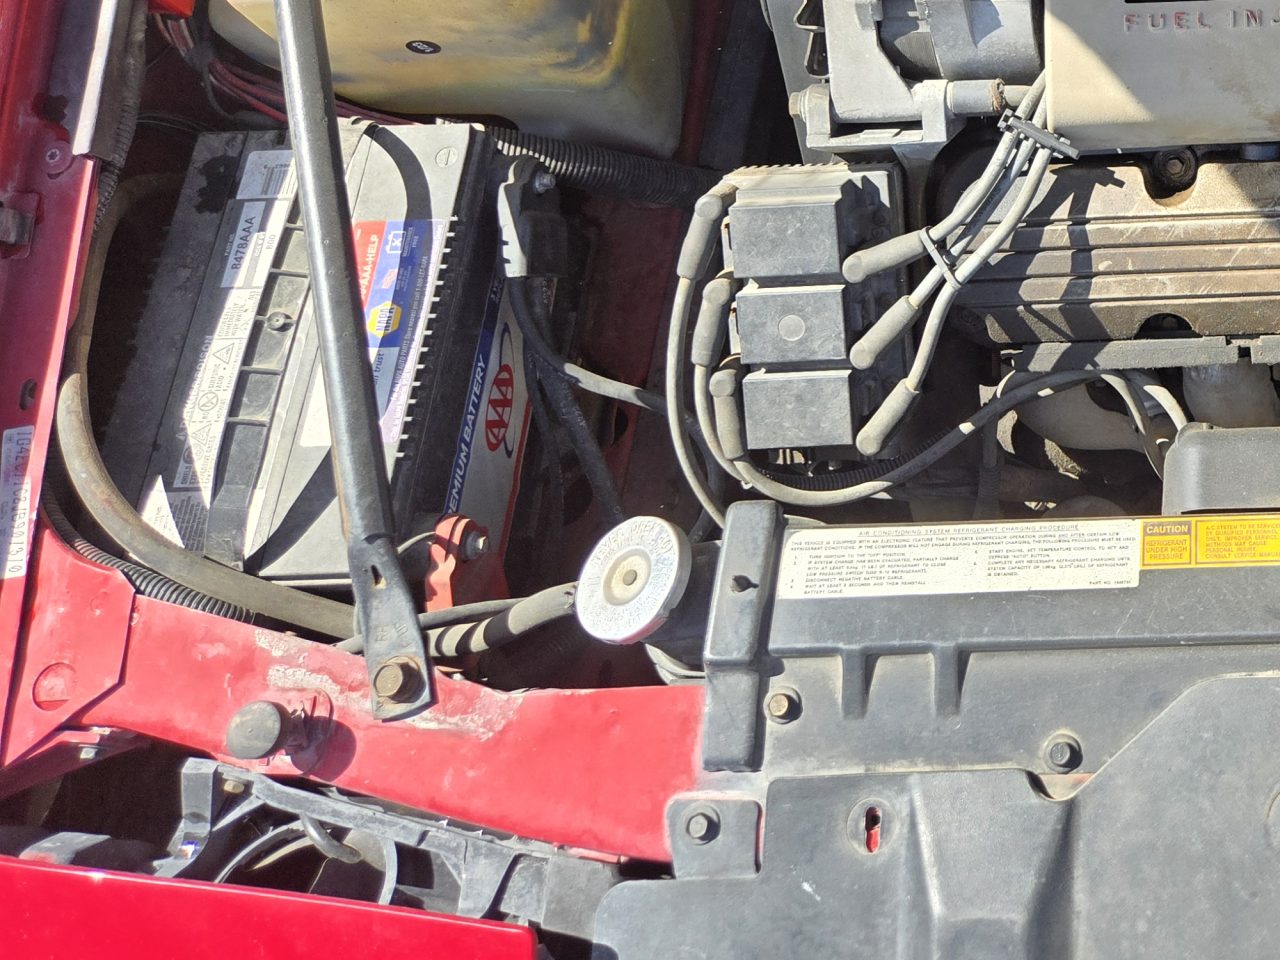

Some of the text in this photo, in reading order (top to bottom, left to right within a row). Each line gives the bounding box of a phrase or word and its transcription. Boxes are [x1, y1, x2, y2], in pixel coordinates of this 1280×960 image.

[1122, 11, 1212, 34] FUEL
[231, 216, 257, 270] 8478AAA
[376, 306, 395, 332] NAPA
[375, 353, 385, 377] trust
[463, 353, 486, 441] BATTERY
[486, 368, 513, 447] AAA
[1146, 525, 1188, 534] CAUTION
[1146, 539, 1187, 547] REFRIGERANT
